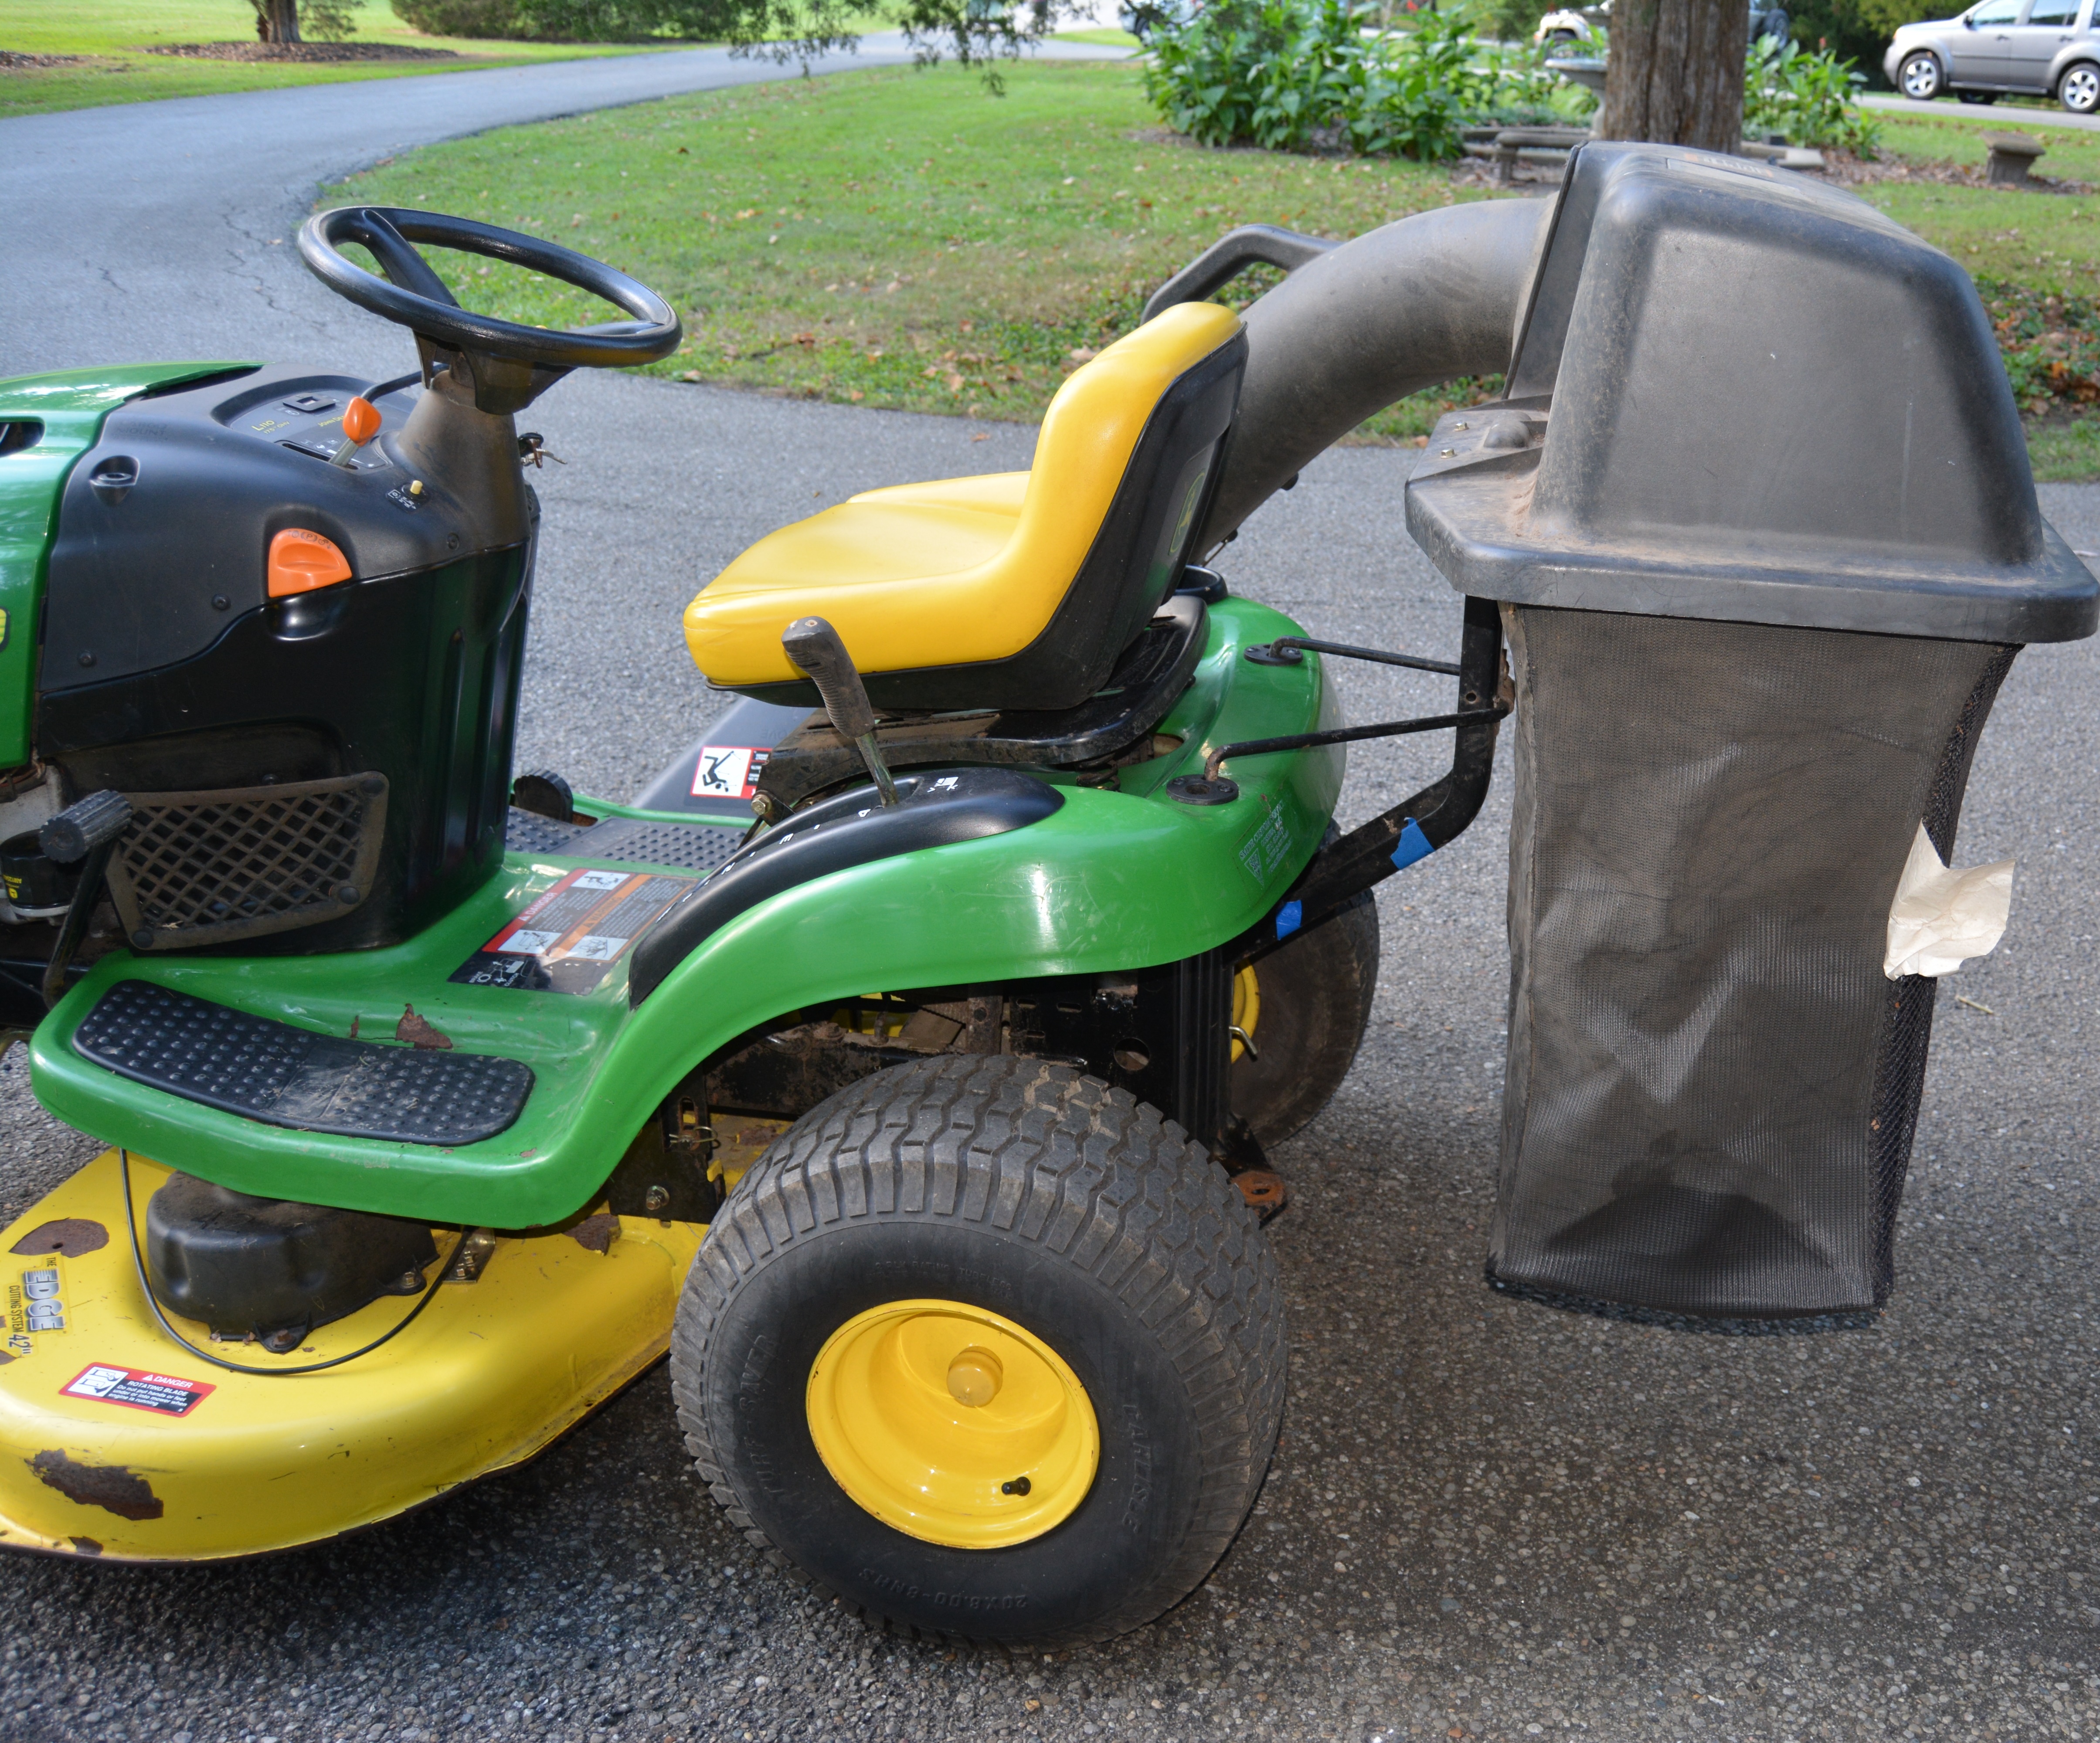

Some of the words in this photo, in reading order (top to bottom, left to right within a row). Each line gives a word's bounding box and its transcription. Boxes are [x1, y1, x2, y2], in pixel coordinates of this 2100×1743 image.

[251, 420, 275, 431] L110
[318, 418, 334, 427] JOHN
[116, 427, 166, 436] MOUNT
[858, 809, 871, 817] 4
[779, 833, 794, 844] 3
[525, 892, 558, 915] DANGER
[591, 896, 623, 922] WARNING
[469, 971, 483, 983] BRAKE
[504, 973, 520, 987] CLUTCH
[46, 1257, 57, 1267] THE
[9, 1285, 22, 1309] CUTTING
[25, 1268, 65, 1331] EDGE
[11, 1309, 24, 1333] SYSTEM
[153, 1376, 194, 1388] DANGER
[127, 1381, 164, 1391] ROTATING
[163, 1387, 189, 1397] BLADE
[135, 1398, 159, 1407] running
